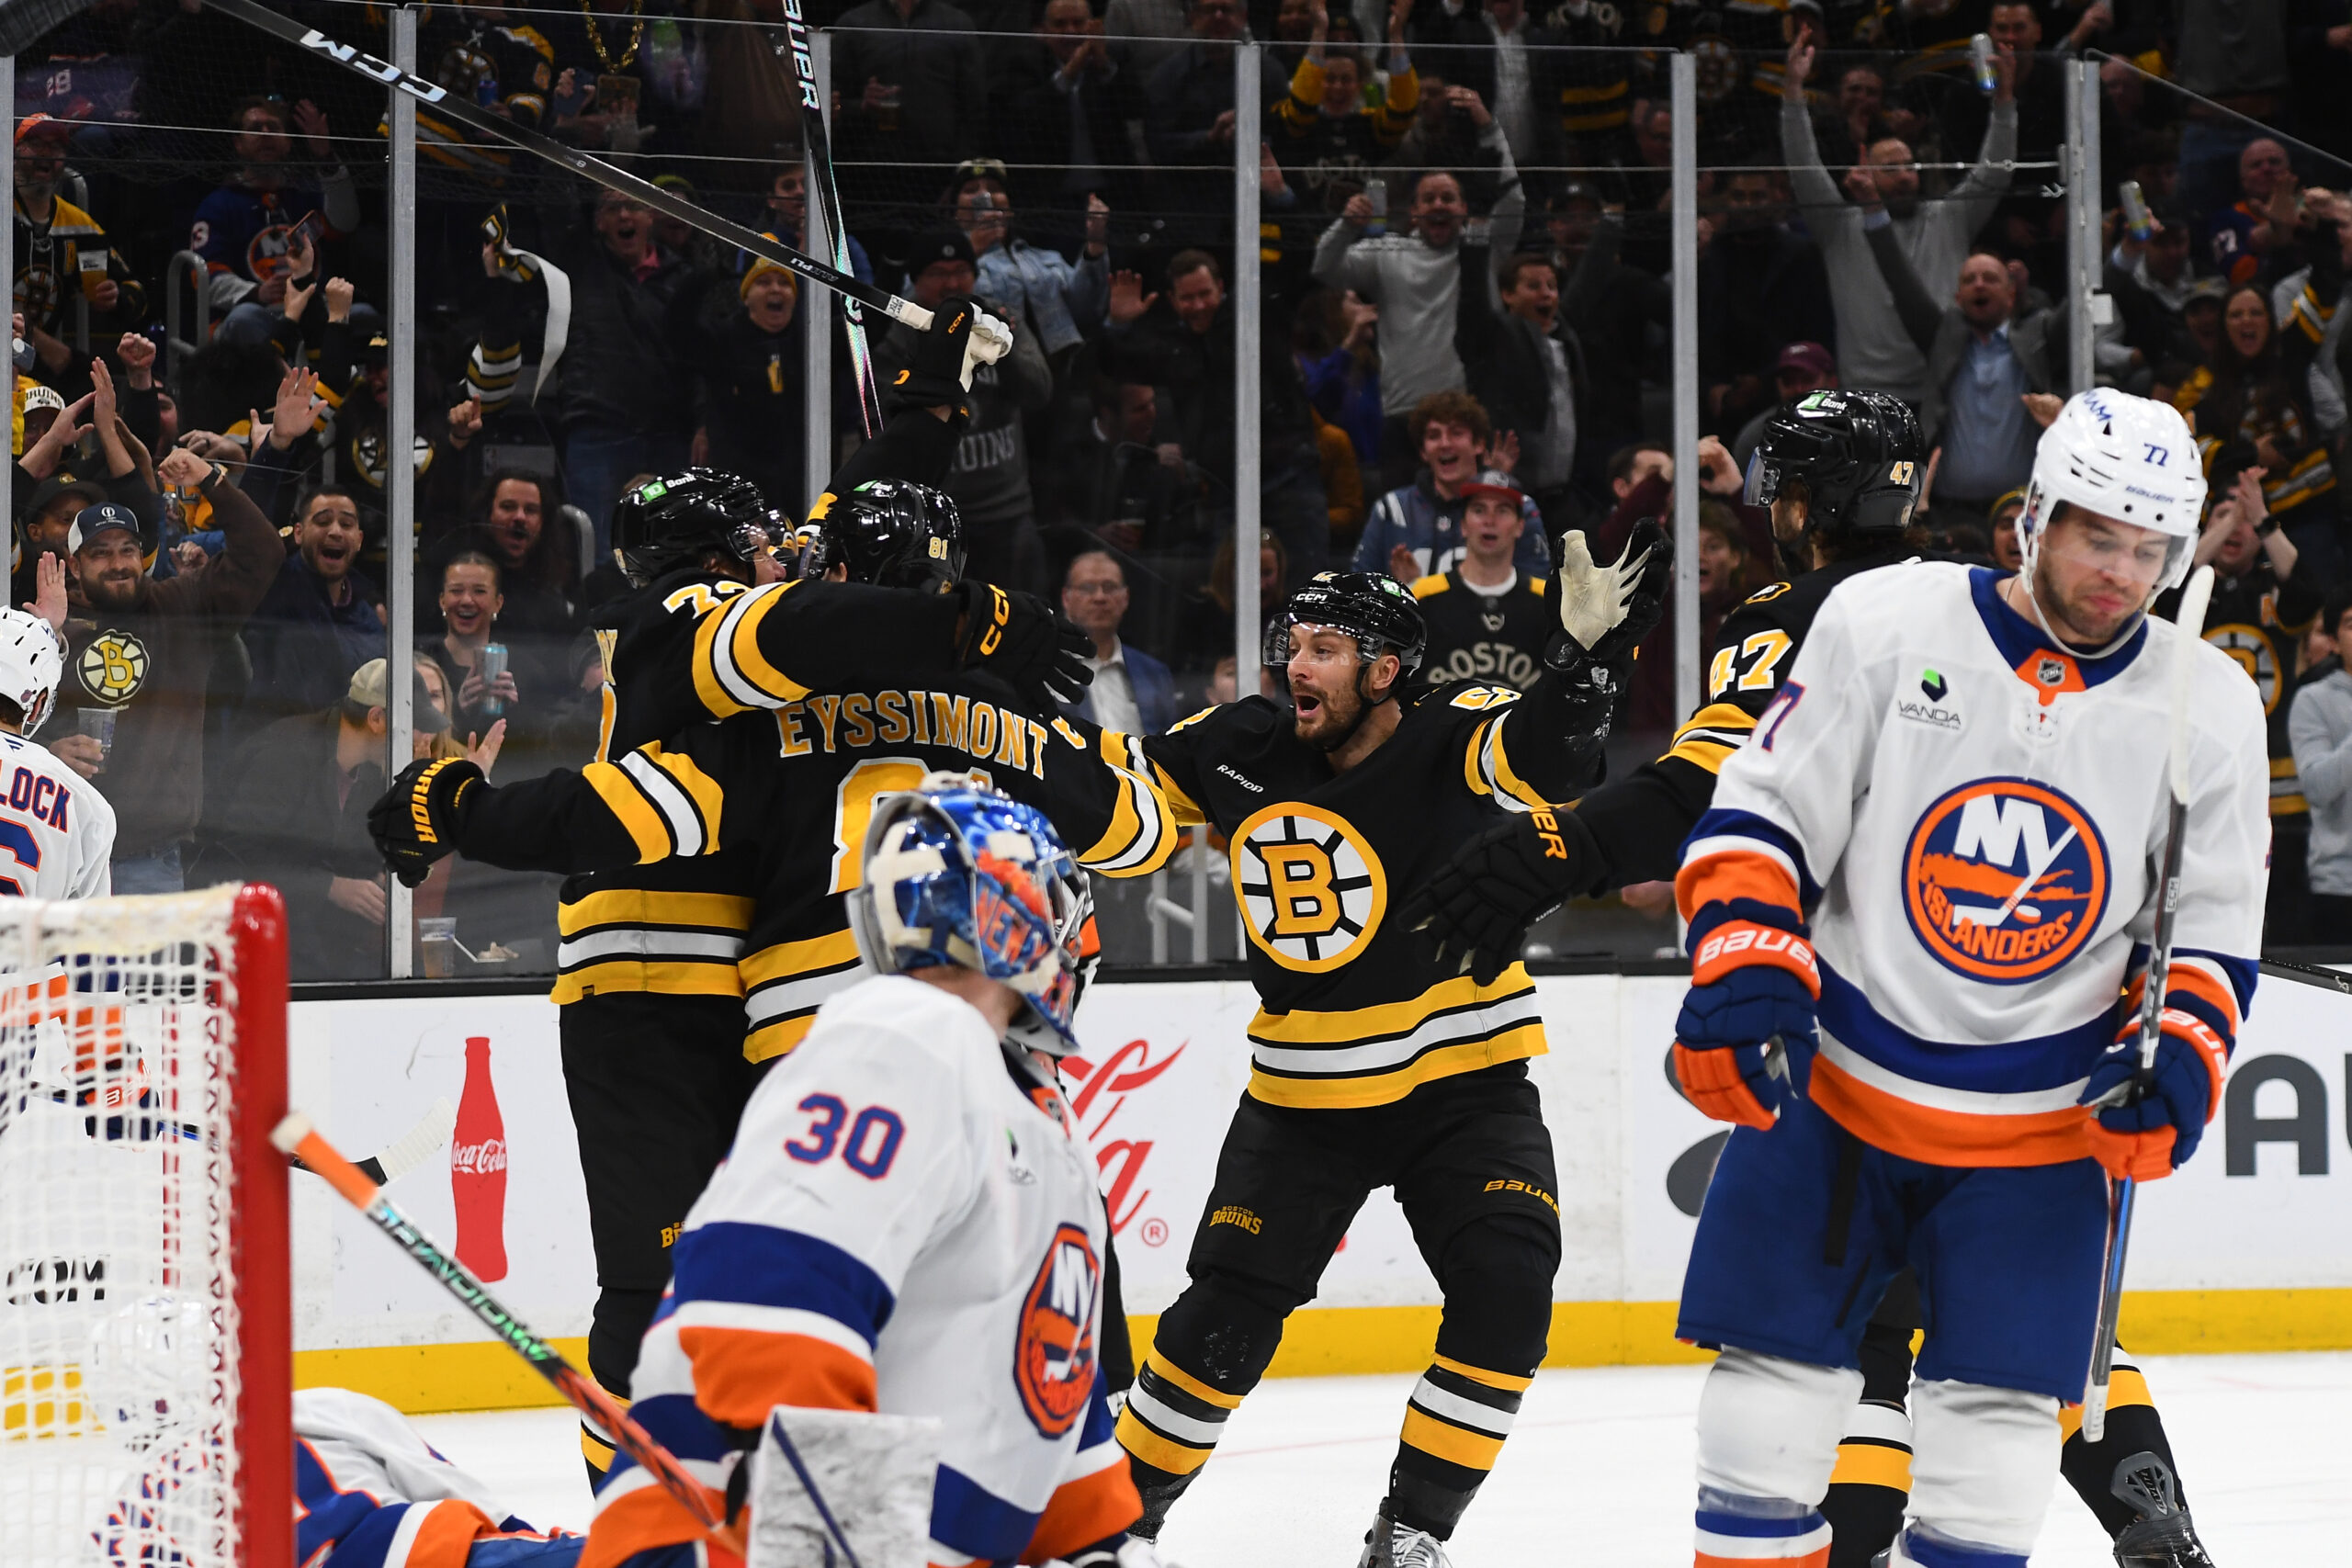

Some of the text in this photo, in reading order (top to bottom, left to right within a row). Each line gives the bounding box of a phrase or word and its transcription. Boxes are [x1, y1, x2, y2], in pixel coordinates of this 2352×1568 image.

[300, 29, 447, 102] CCM
[947, 310, 967, 334] CCM
[1821, 398, 1848, 411] Bank
[2143, 443, 2168, 467] 77
[666, 473, 696, 488] Bank
[1890, 461, 1914, 485] 47
[928, 536, 949, 560] 81
[1295, 592, 1329, 602] CCM
[1710, 629, 1793, 703] 47
[1898, 699, 1962, 727] VANDA
[774, 689, 1047, 781] EYSSIMONT
[1953, 794, 2060, 877] NY
[1260, 842, 1341, 935] B
[1923, 880, 2074, 961] ISLANDERS
[784, 1092, 905, 1180] 30
[1208, 1210, 1263, 1235] BRUINS
[1222, 1204, 1255, 1217] BOSTON
